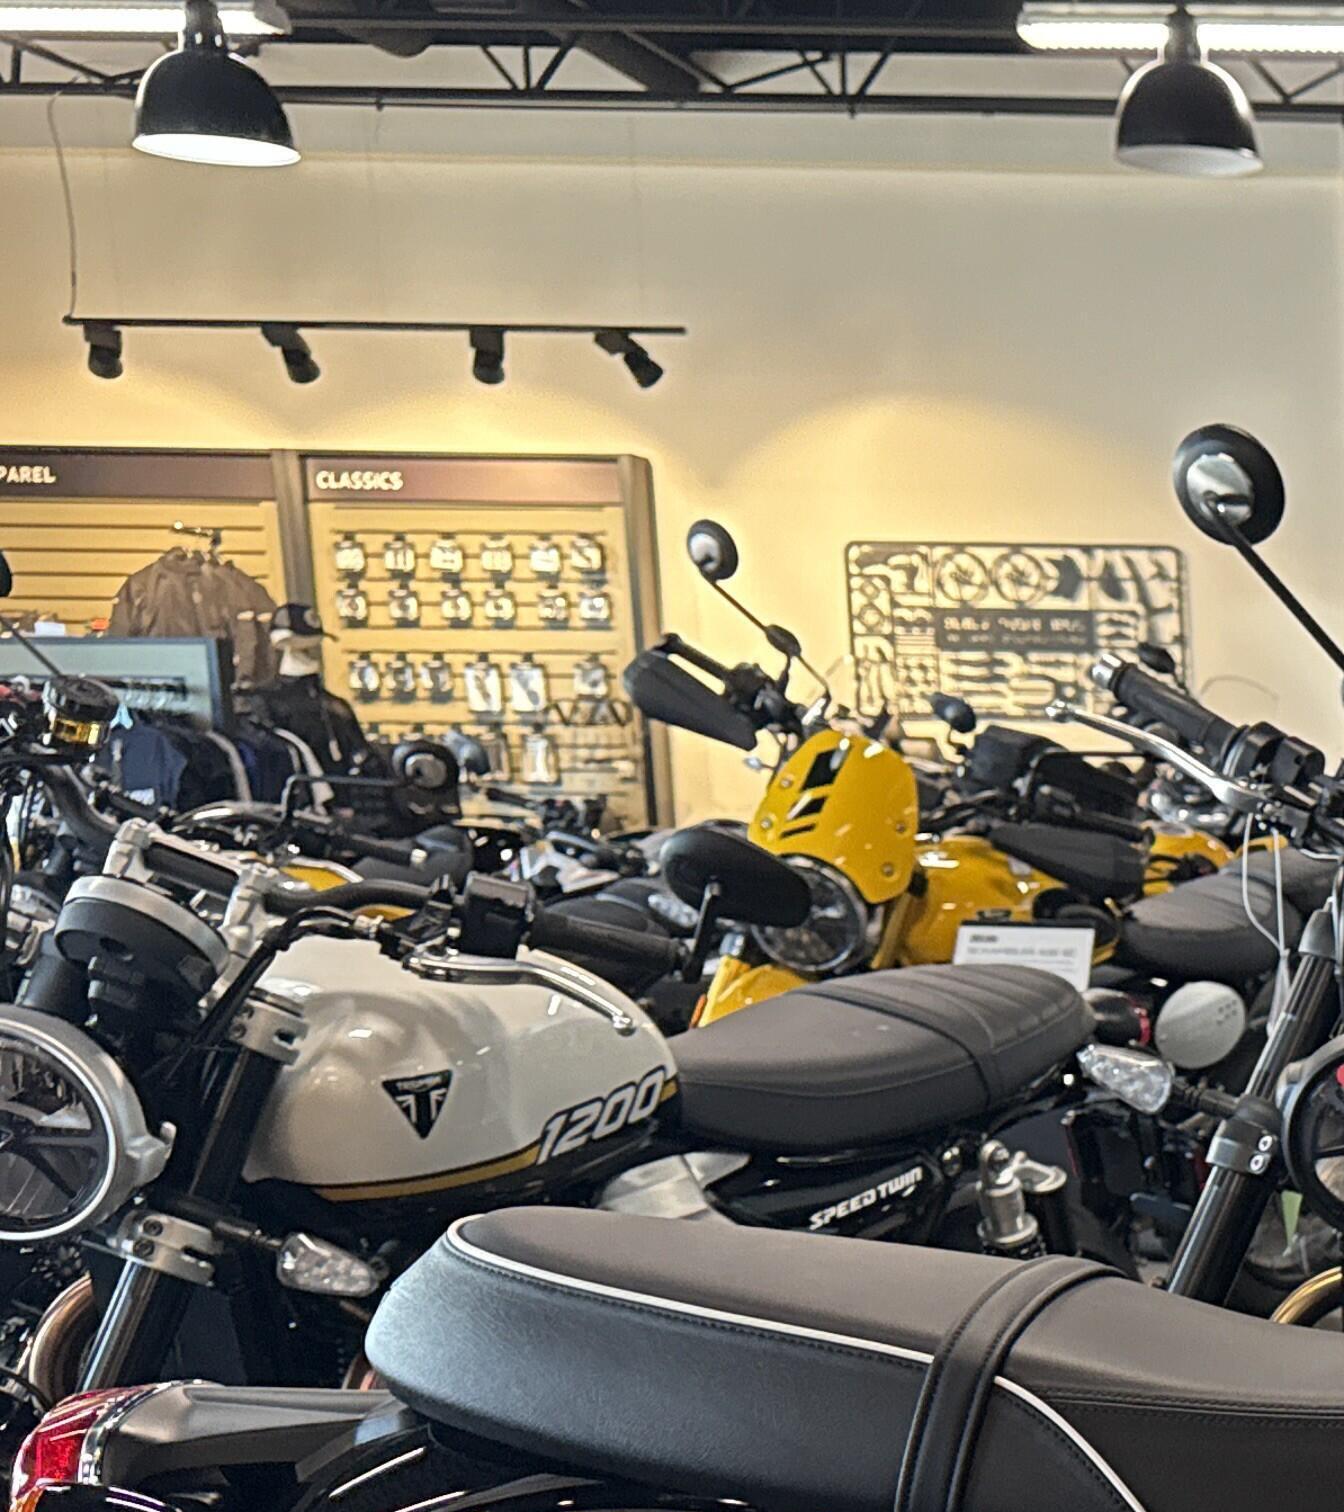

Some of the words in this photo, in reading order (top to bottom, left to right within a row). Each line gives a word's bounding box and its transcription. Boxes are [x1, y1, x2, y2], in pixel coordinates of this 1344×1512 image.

[315, 470, 404, 491] CLASSICS
[536, 1064, 666, 1166] 1200
[808, 1187, 878, 1231] SPEED
[877, 1165, 923, 1199] TWIN
